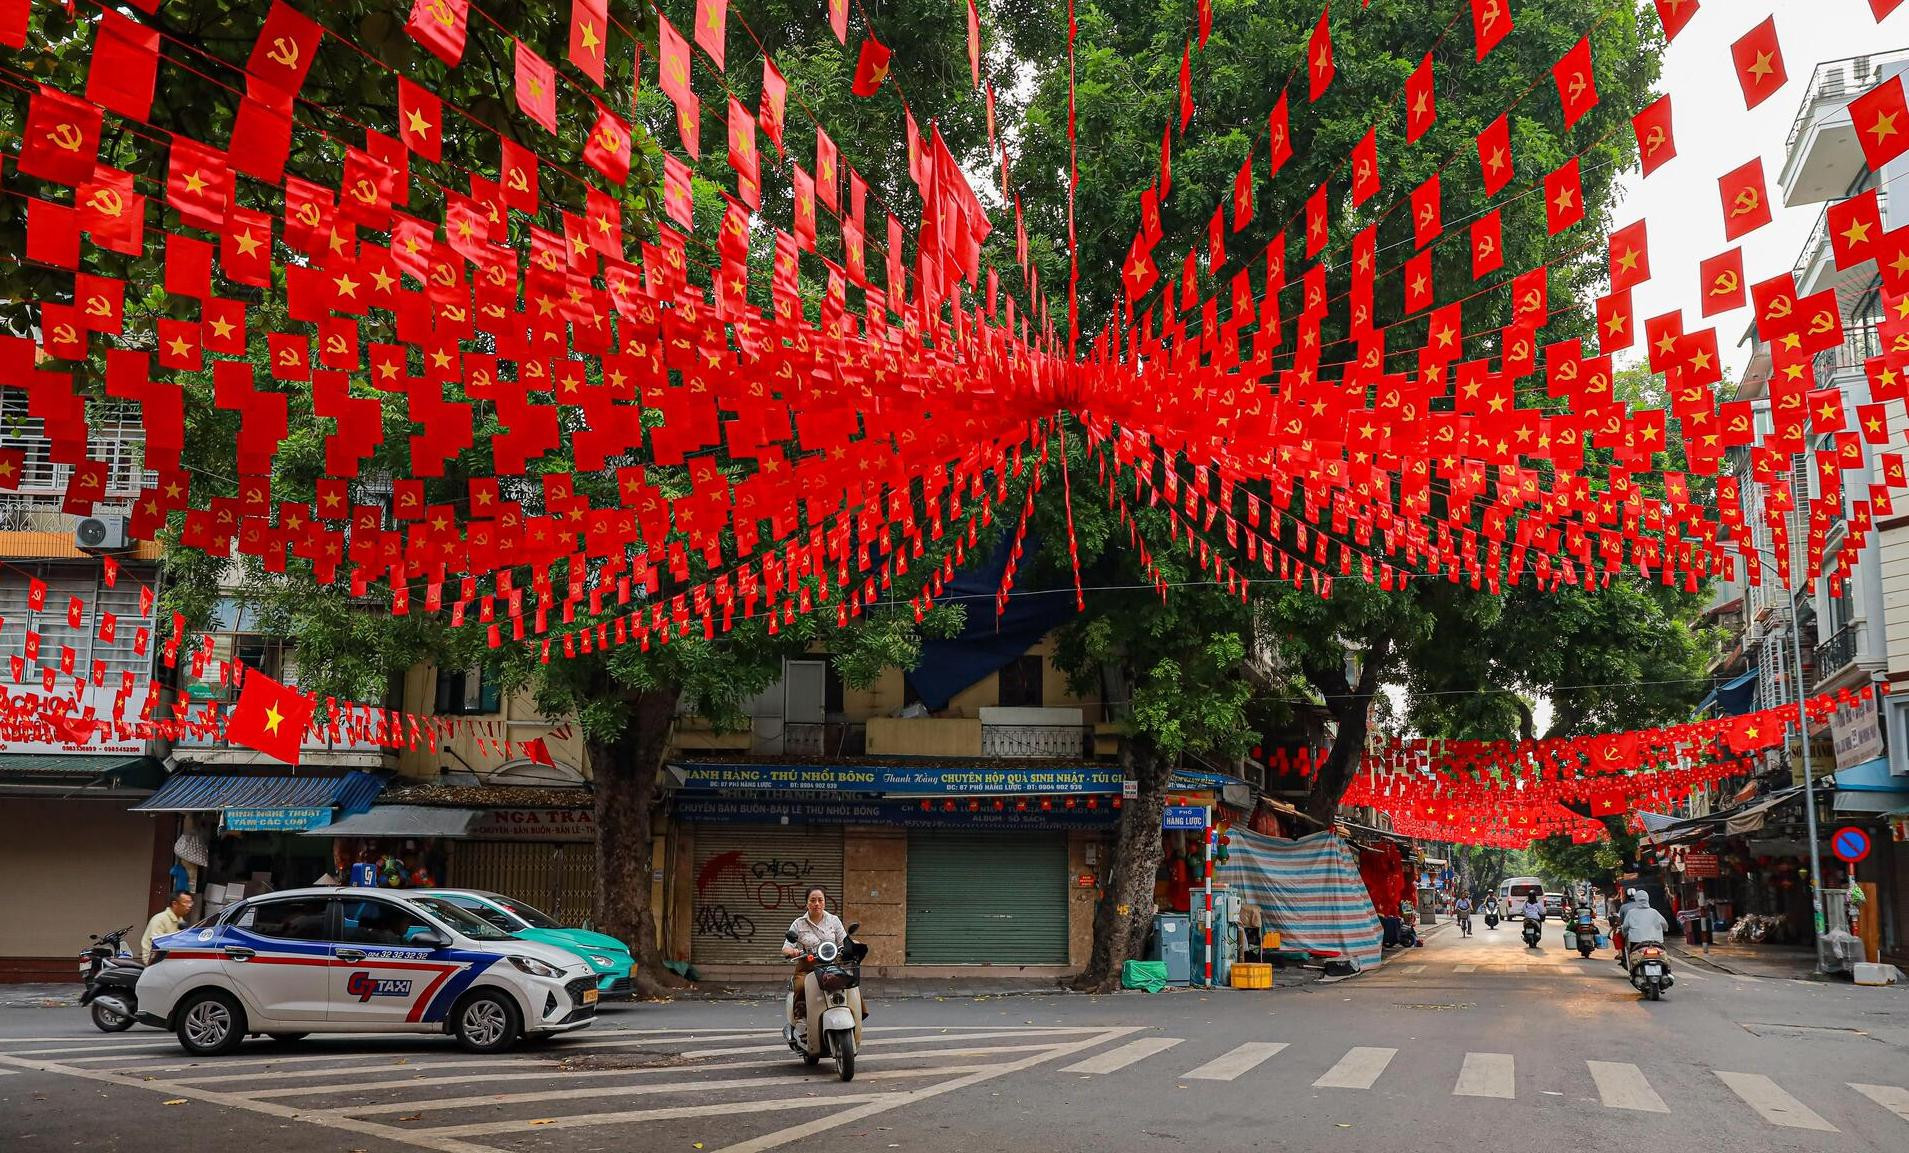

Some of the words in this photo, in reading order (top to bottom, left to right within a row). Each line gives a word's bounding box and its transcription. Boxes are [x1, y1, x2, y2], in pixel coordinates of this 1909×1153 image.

[770, 769, 798, 781] THÚ
[802, 768, 835, 782] NHỒI
[838, 770, 875, 783] BÔNG
[883, 773, 911, 783] Thanh
[941, 771, 982, 783] CHUYÊN
[984, 771, 1005, 785] HỘP
[1030, 773, 1054, 783] SINH
[1056, 771, 1085, 784] NHẬT
[1092, 772, 1109, 783] TÚI
[496, 811, 540, 823] NGA
[545, 811, 594, 823] TRA
[1166, 816, 1184, 825] HÀNG
[1185, 817, 1203, 827] LƯỢC
[1116, 904, 1130, 915] 45
[378, 980, 411, 992] TAXI
